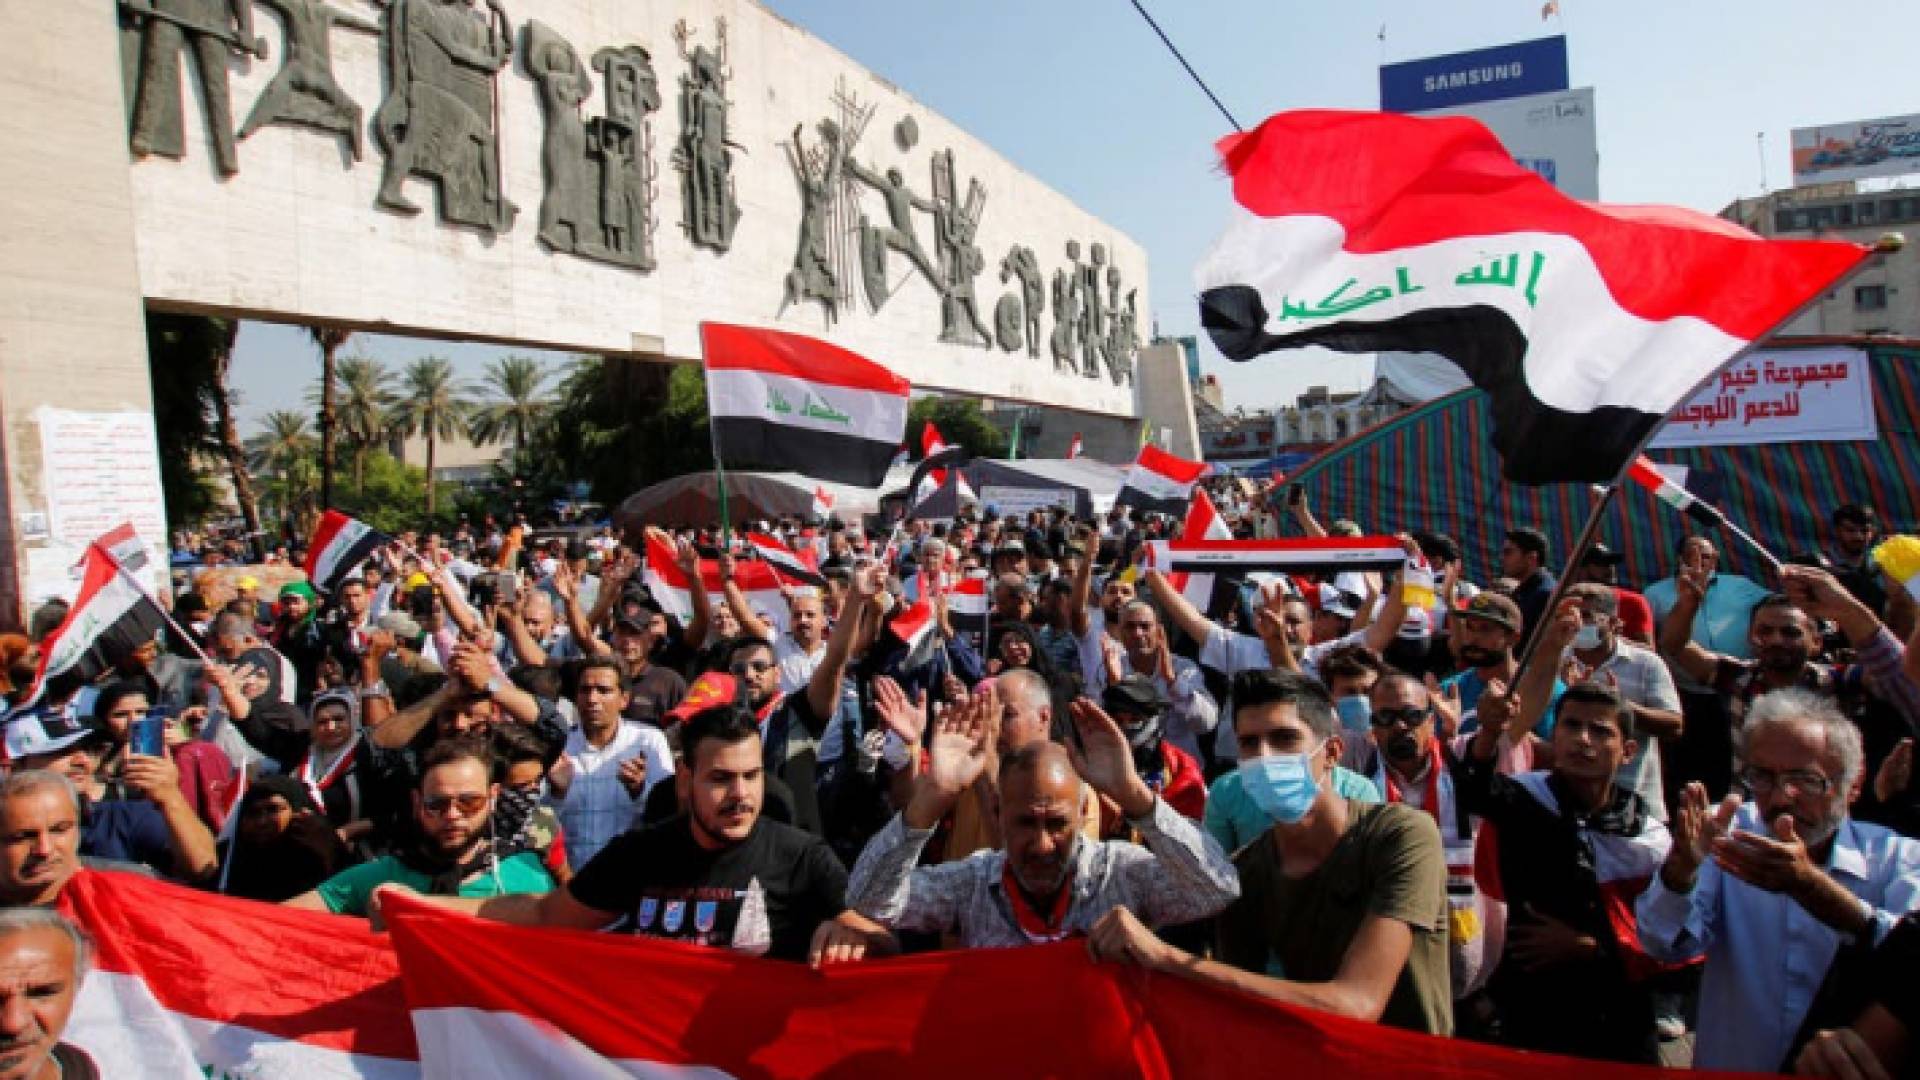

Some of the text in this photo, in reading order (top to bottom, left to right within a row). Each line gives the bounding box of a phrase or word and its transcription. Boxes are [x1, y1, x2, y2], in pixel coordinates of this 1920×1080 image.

[1424, 62, 1523, 92] SAMSUNG
[1719, 360, 1848, 393] مجموعة خيم
[1743, 391, 1800, 427] للدعم
